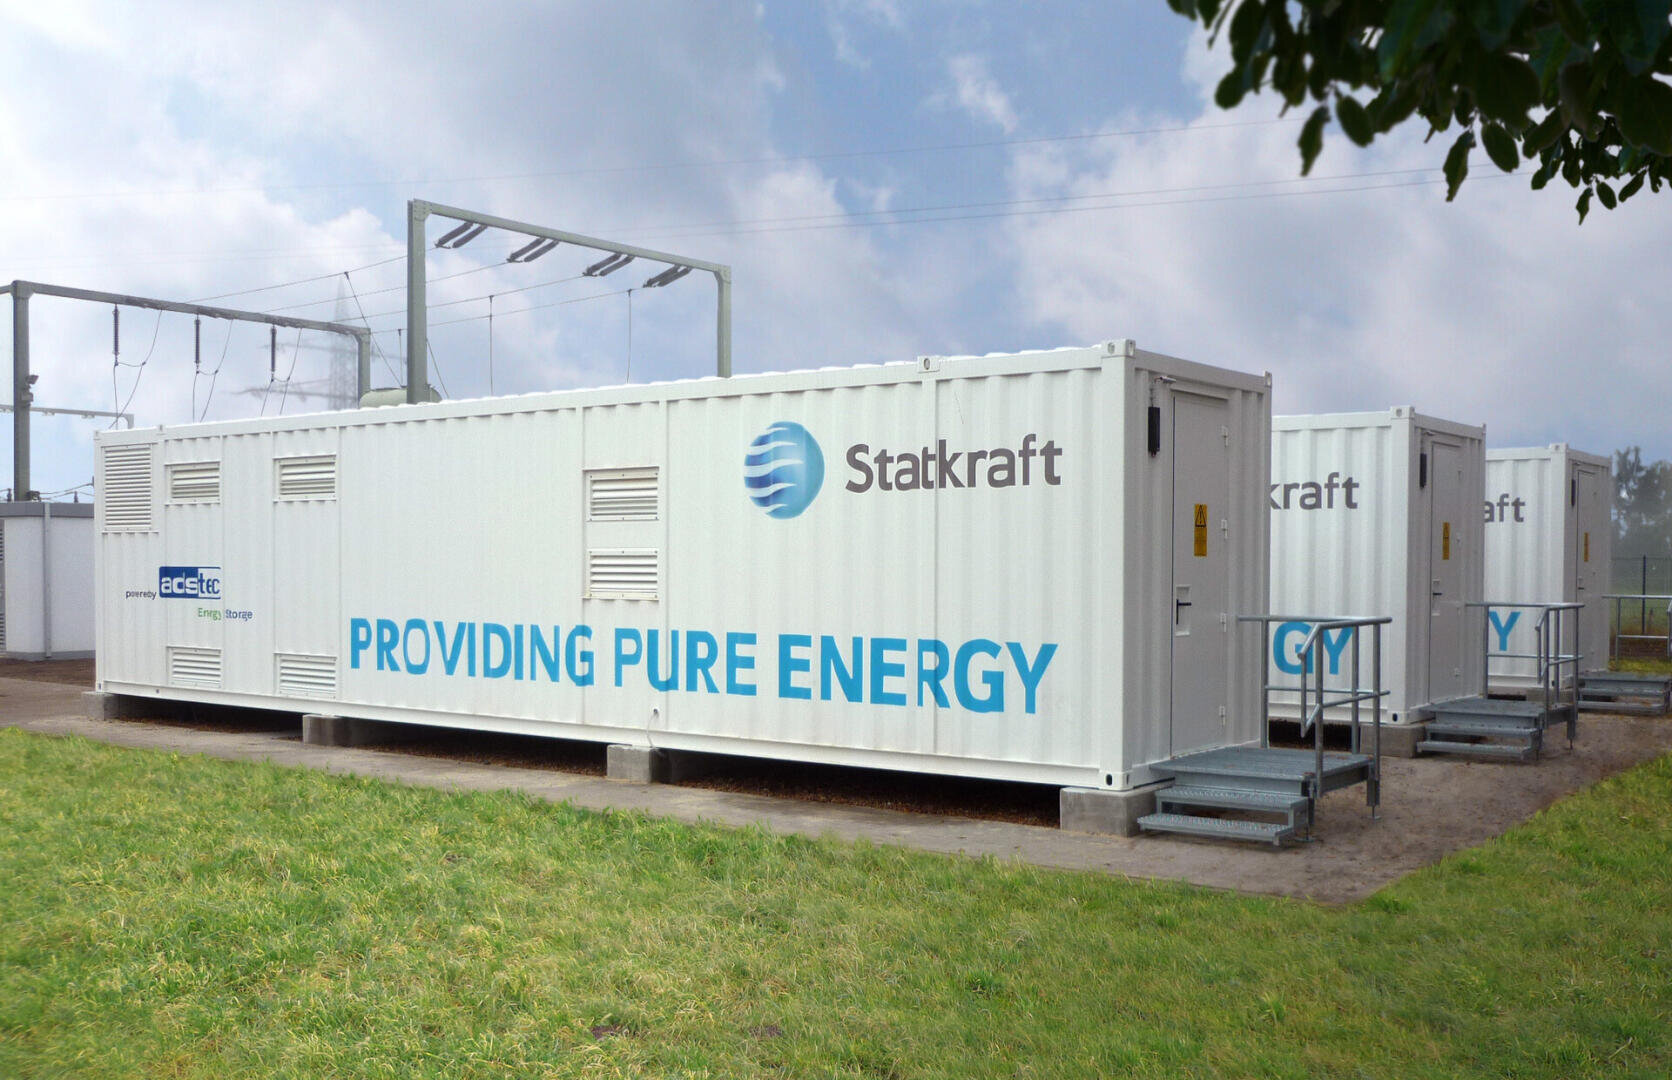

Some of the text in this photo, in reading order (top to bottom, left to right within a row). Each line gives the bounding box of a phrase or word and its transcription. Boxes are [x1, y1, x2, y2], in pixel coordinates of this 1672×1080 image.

[845, 433, 1063, 493] Statkraft
[350, 617, 1059, 715] PROVIDING PURE ENERGY
